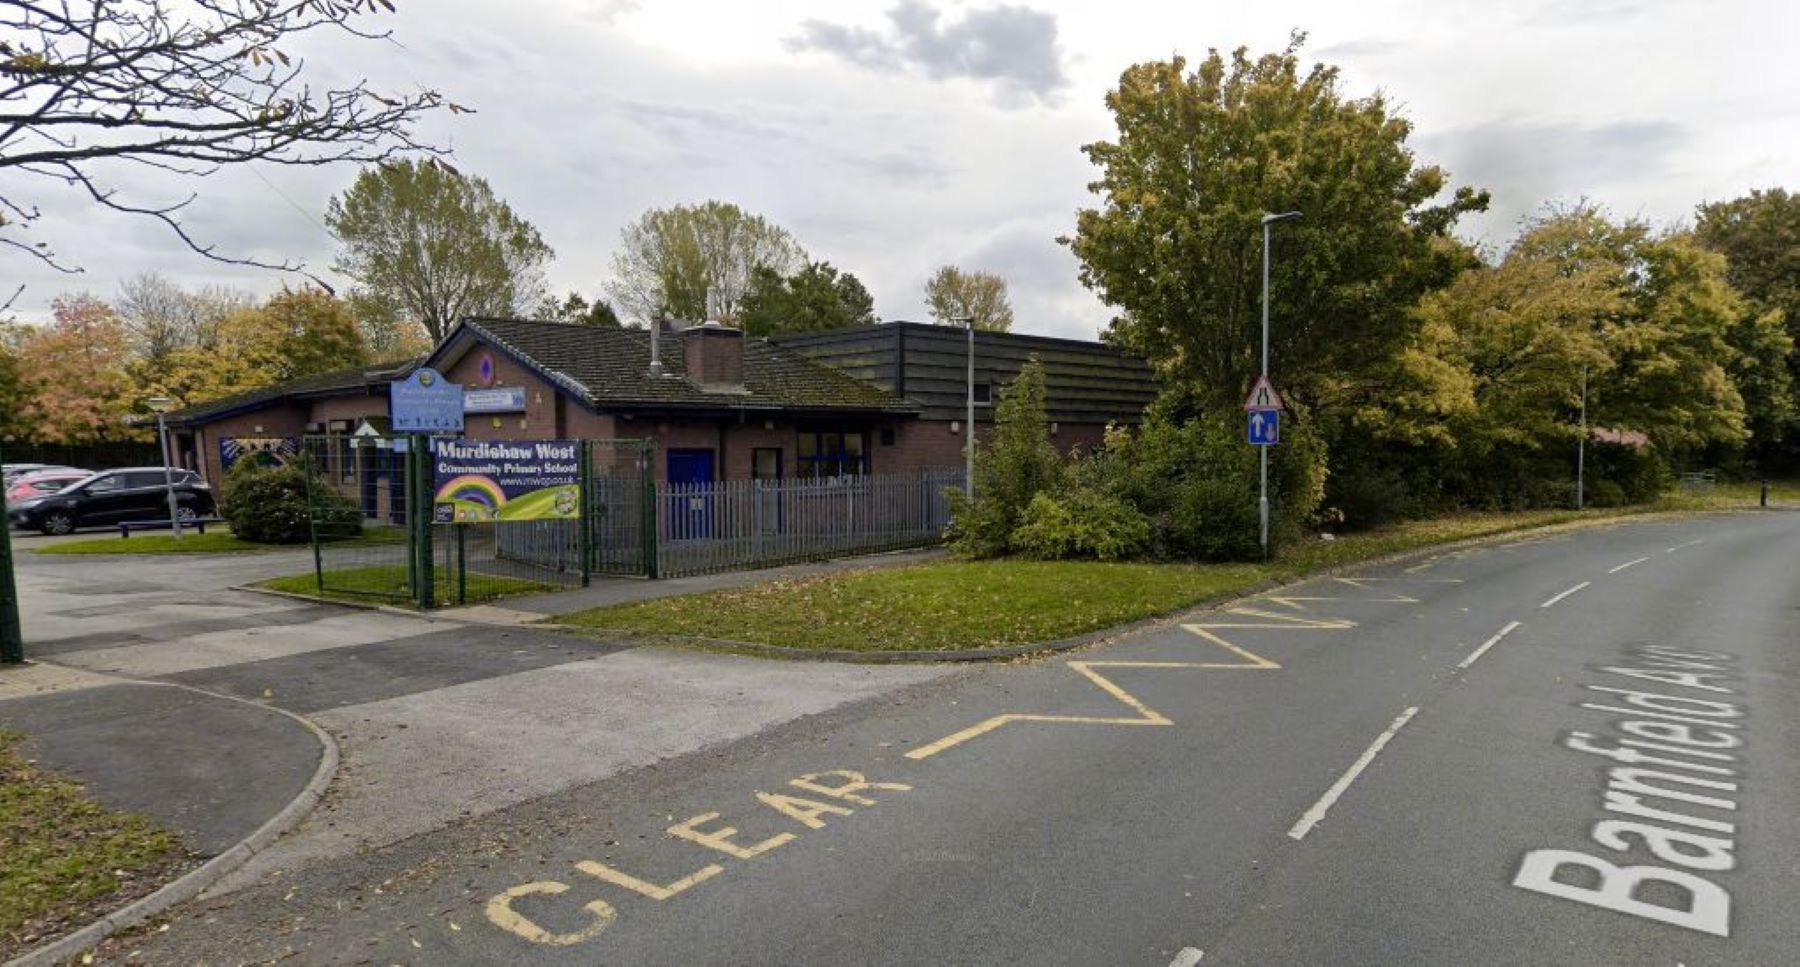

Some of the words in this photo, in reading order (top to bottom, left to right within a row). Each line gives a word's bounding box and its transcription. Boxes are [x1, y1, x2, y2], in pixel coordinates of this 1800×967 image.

[438, 442, 532, 459] Murdishaw
[536, 443, 575, 459] West
[438, 463, 501, 476] Community
[504, 463, 541, 475] Primary
[544, 463, 577, 473] School
[485, 770, 913, 946] CLEAR
